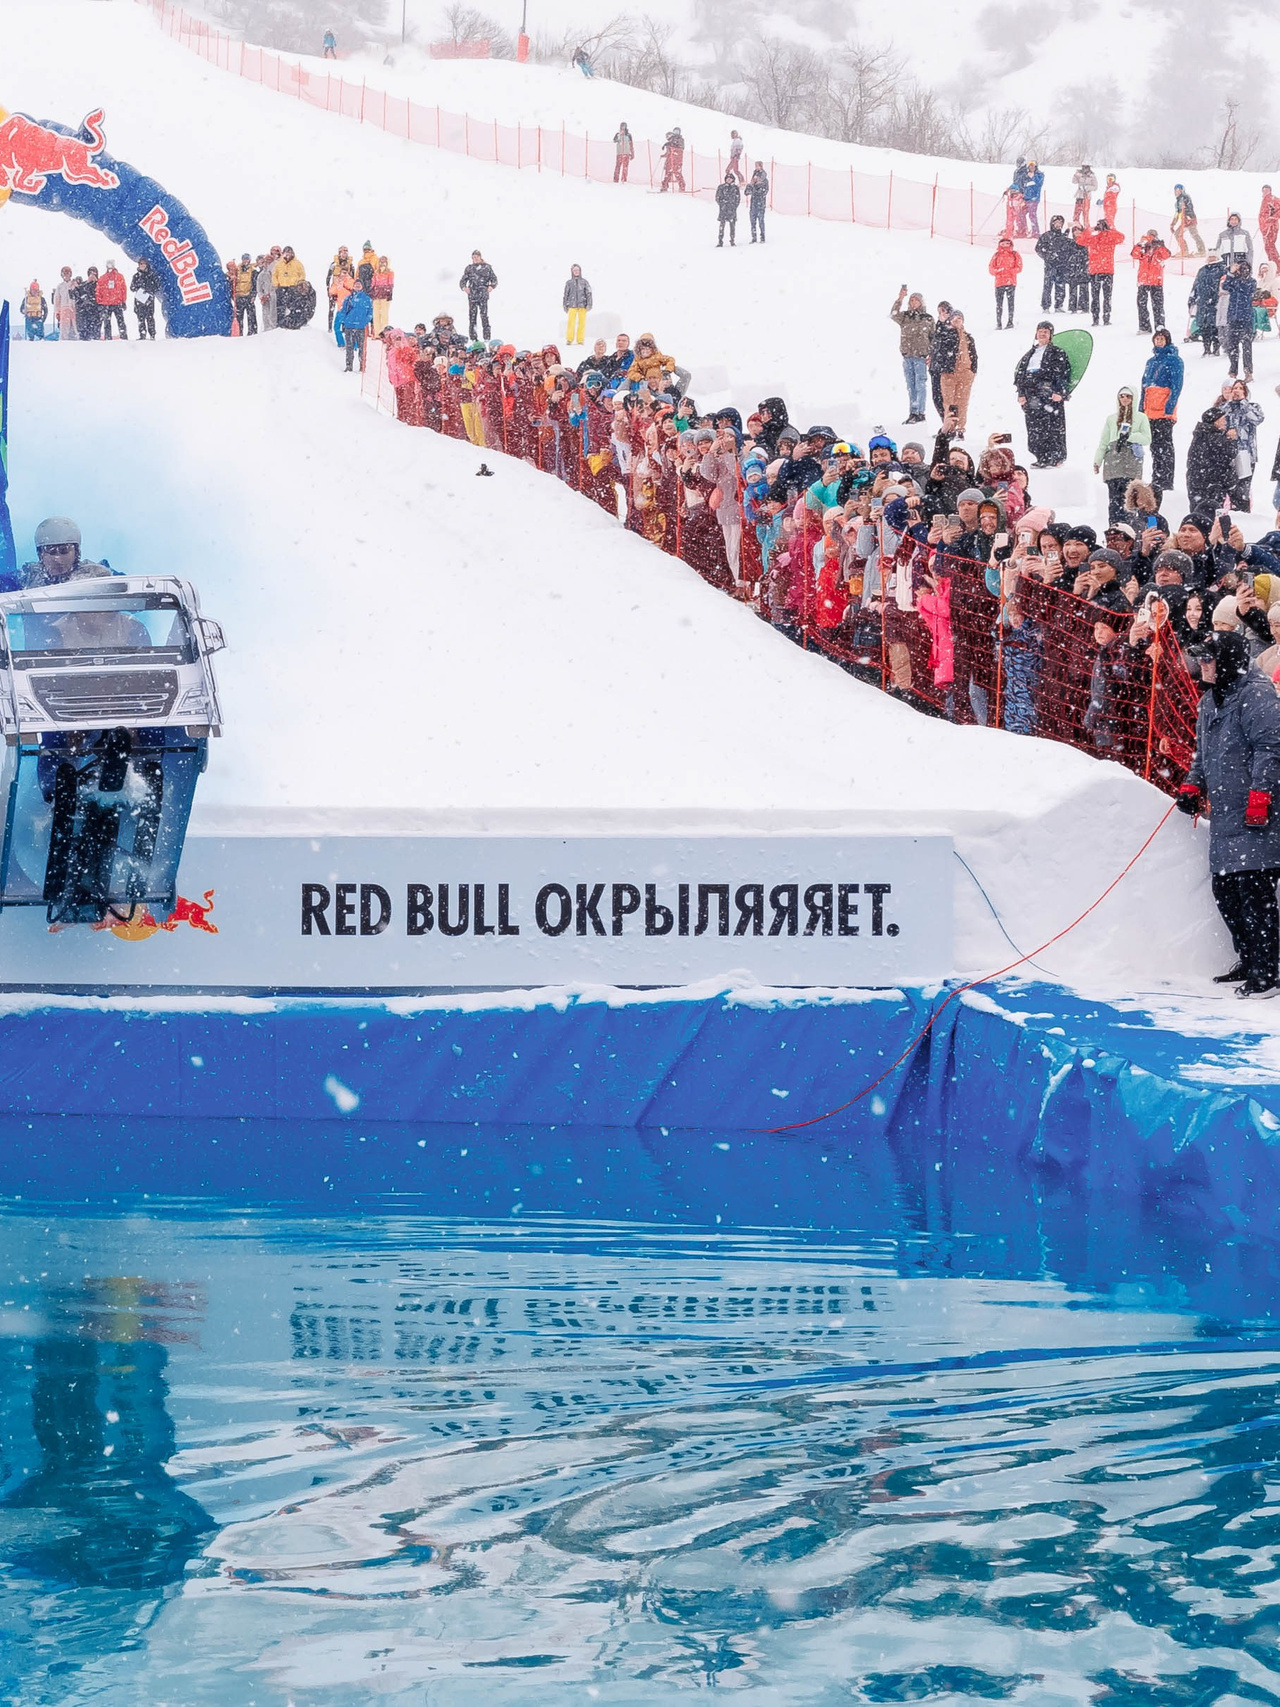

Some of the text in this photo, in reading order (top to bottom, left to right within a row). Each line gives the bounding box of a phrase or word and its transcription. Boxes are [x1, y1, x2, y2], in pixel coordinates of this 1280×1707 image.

[301, 883, 900, 937] RED BULL ОКРЫЛЯЯЯЕТ.
